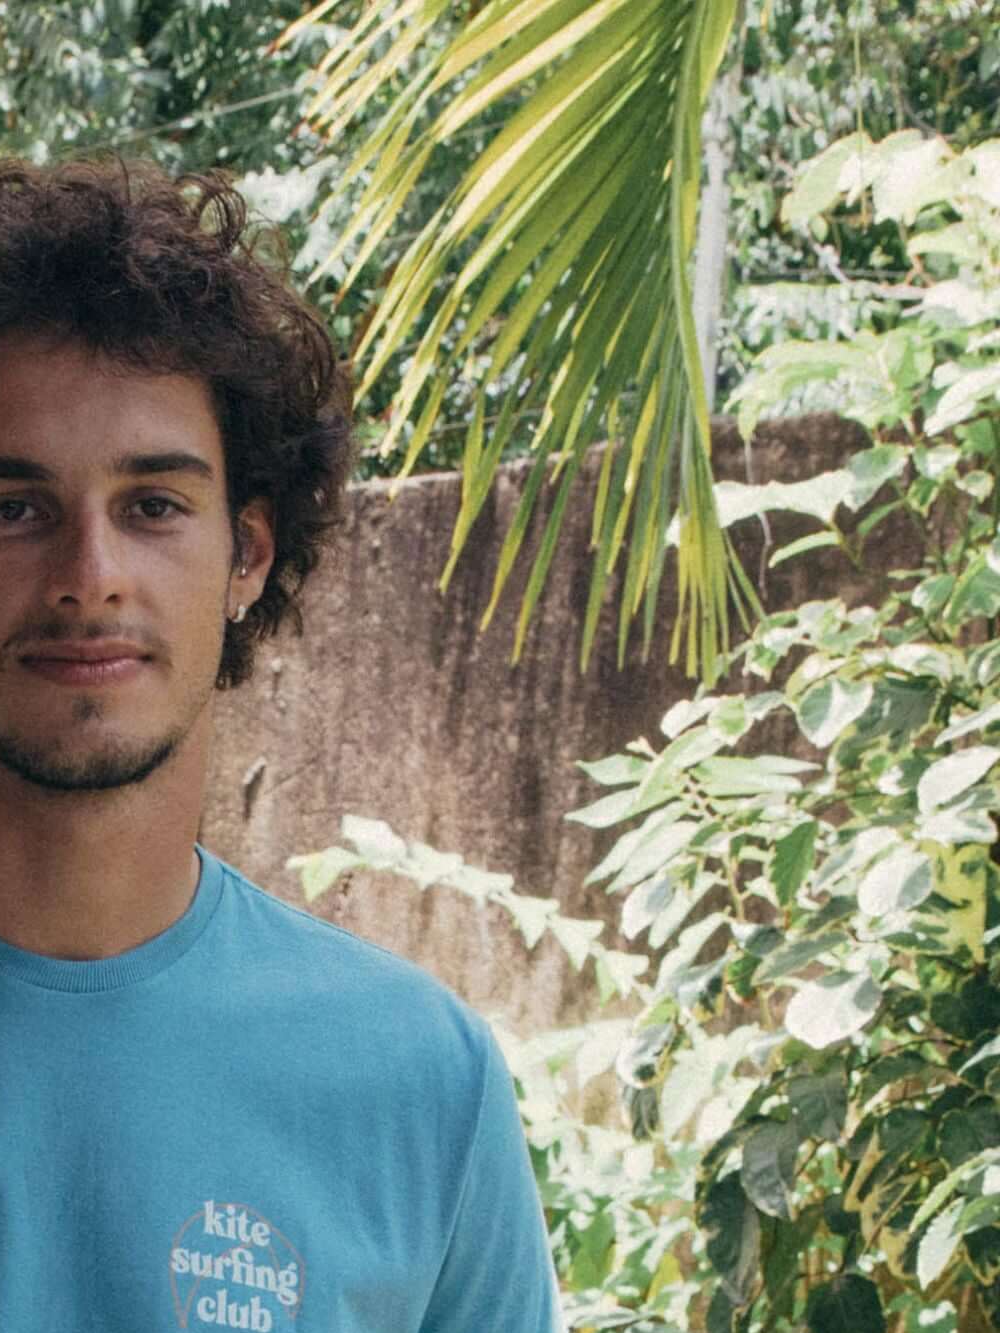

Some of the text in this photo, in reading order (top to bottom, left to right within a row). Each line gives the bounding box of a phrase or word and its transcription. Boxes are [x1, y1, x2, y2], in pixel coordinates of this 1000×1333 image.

[204, 1200, 270, 1246] kite
[171, 1248, 298, 1305] surfing
[197, 1288, 273, 1333] club
